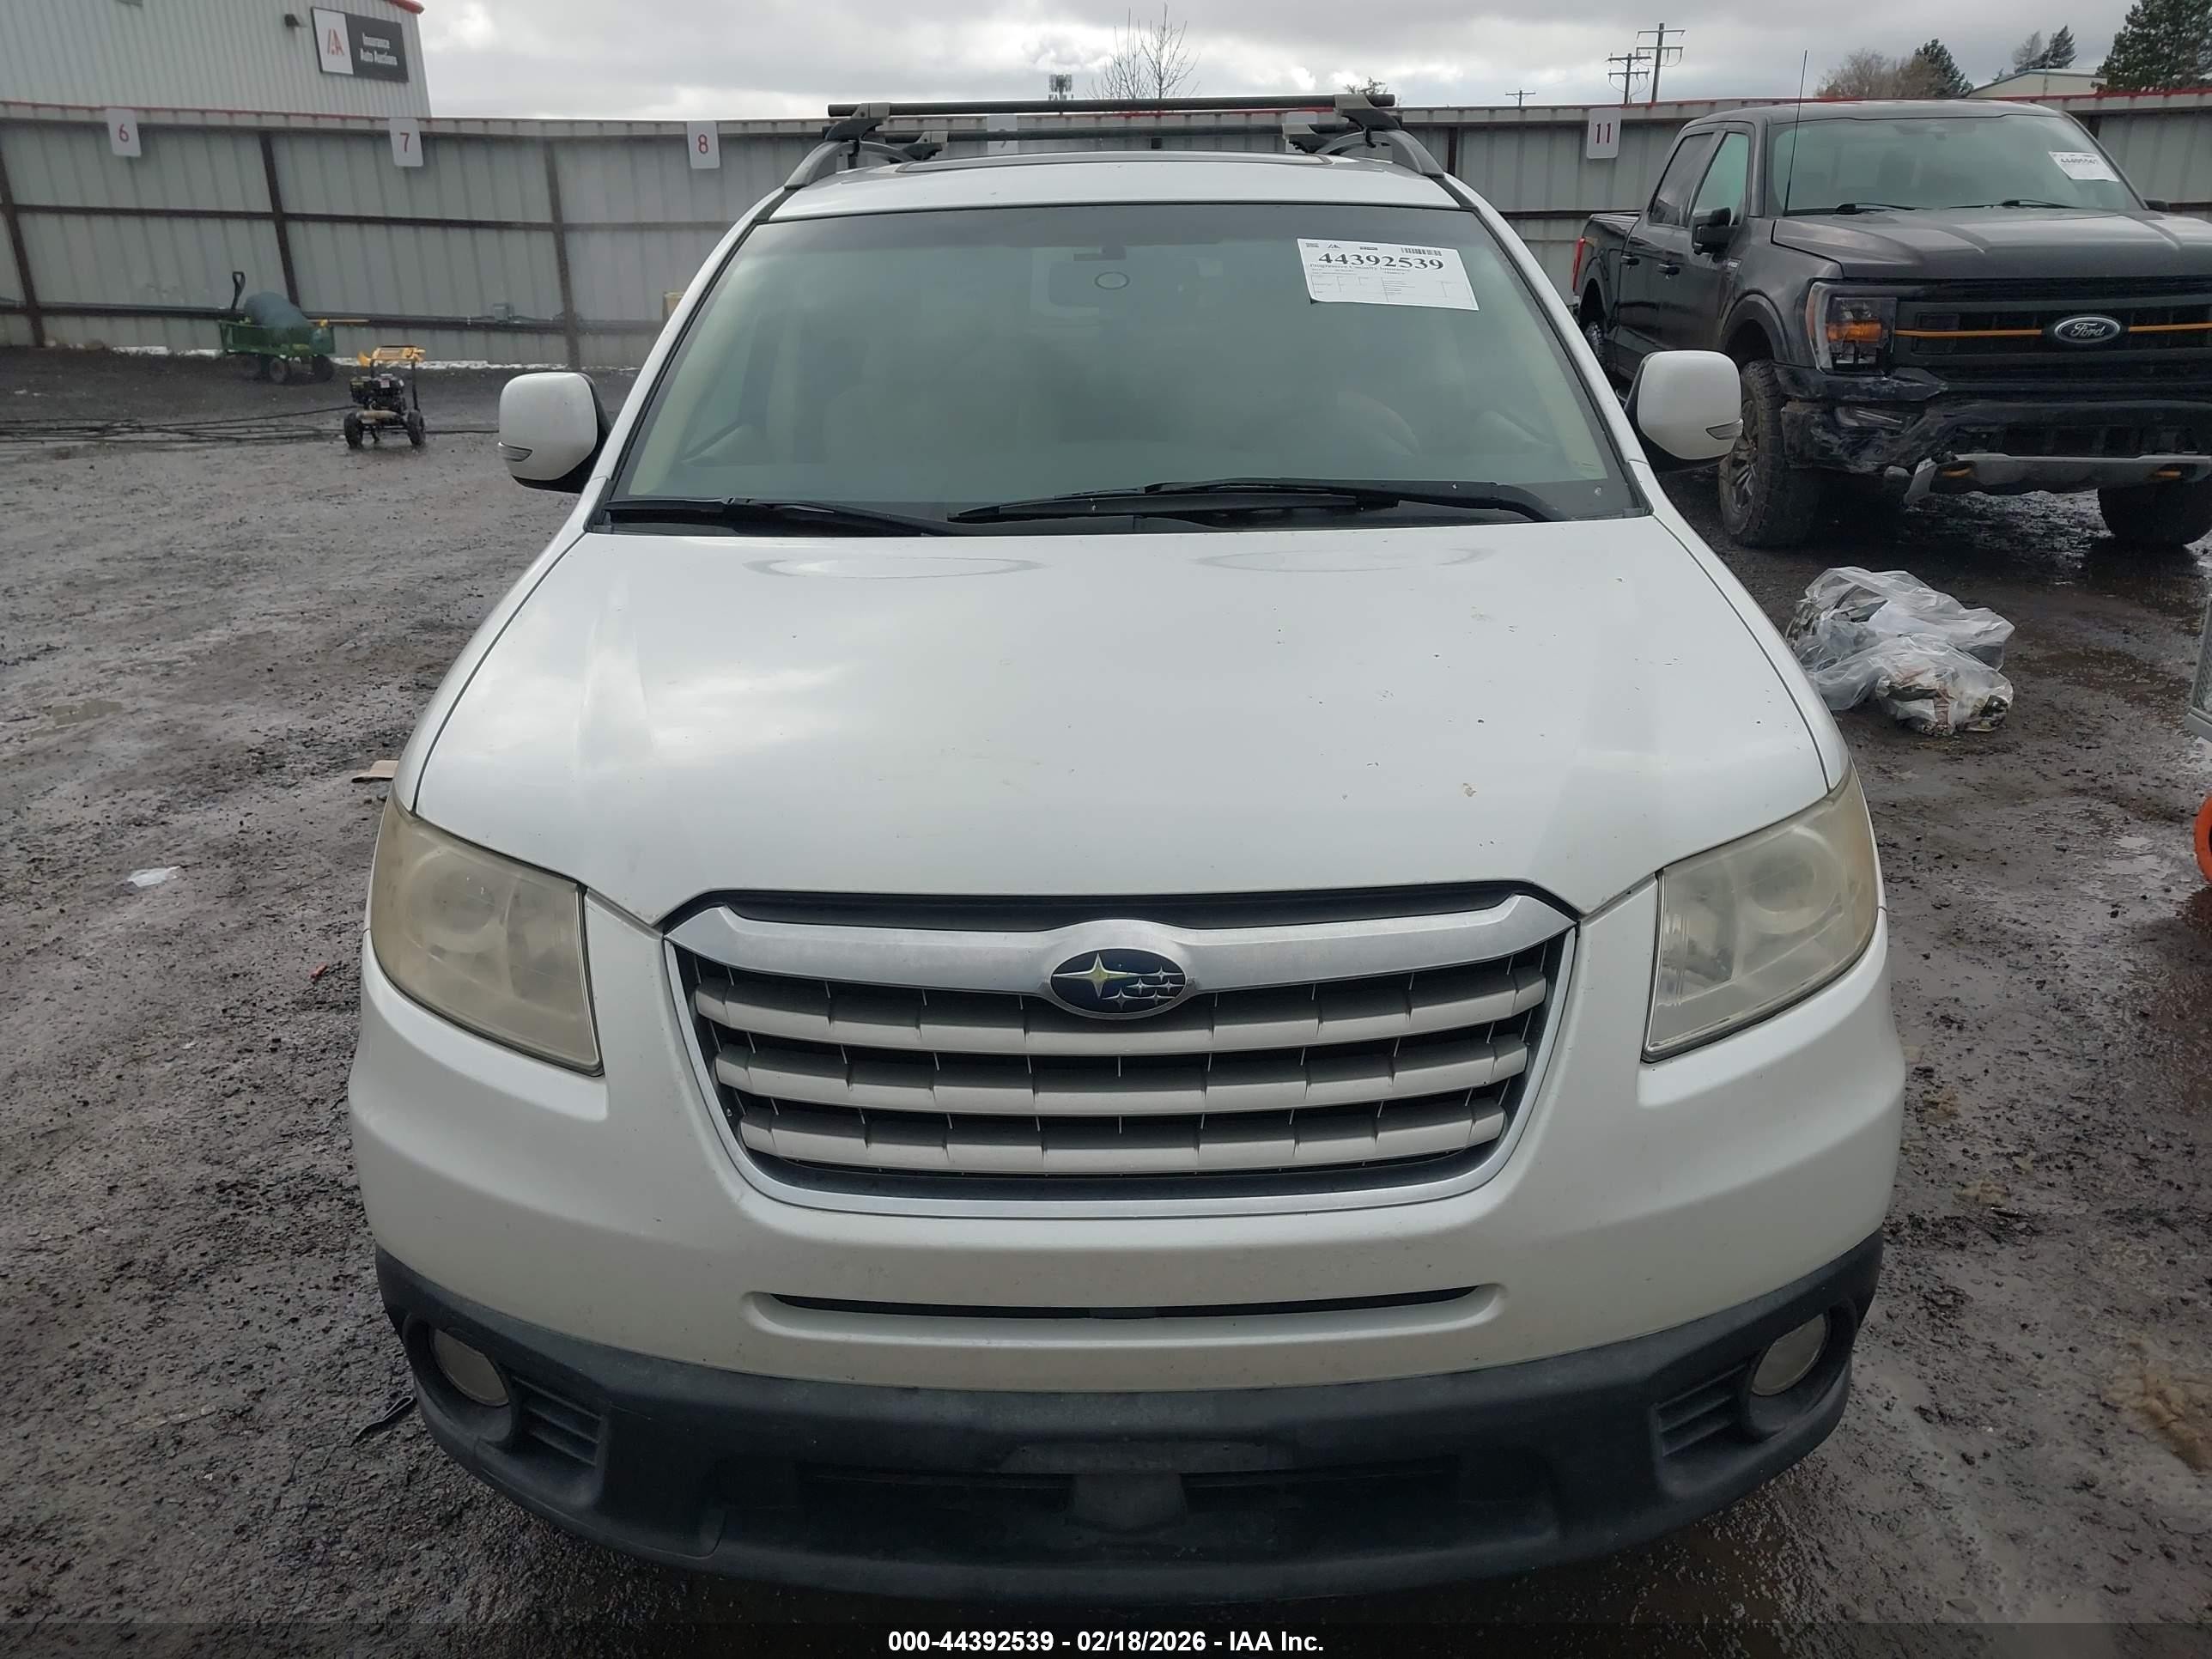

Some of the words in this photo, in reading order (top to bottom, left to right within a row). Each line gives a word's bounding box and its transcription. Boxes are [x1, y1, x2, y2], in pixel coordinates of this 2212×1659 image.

[118, 124, 129, 142] 6
[399, 132, 410, 152] 7
[1596, 122, 1611, 143] 11
[697, 134, 708, 154] 8
[1318, 252, 1443, 270] 44392539
[2070, 322, 2106, 337] Ford
